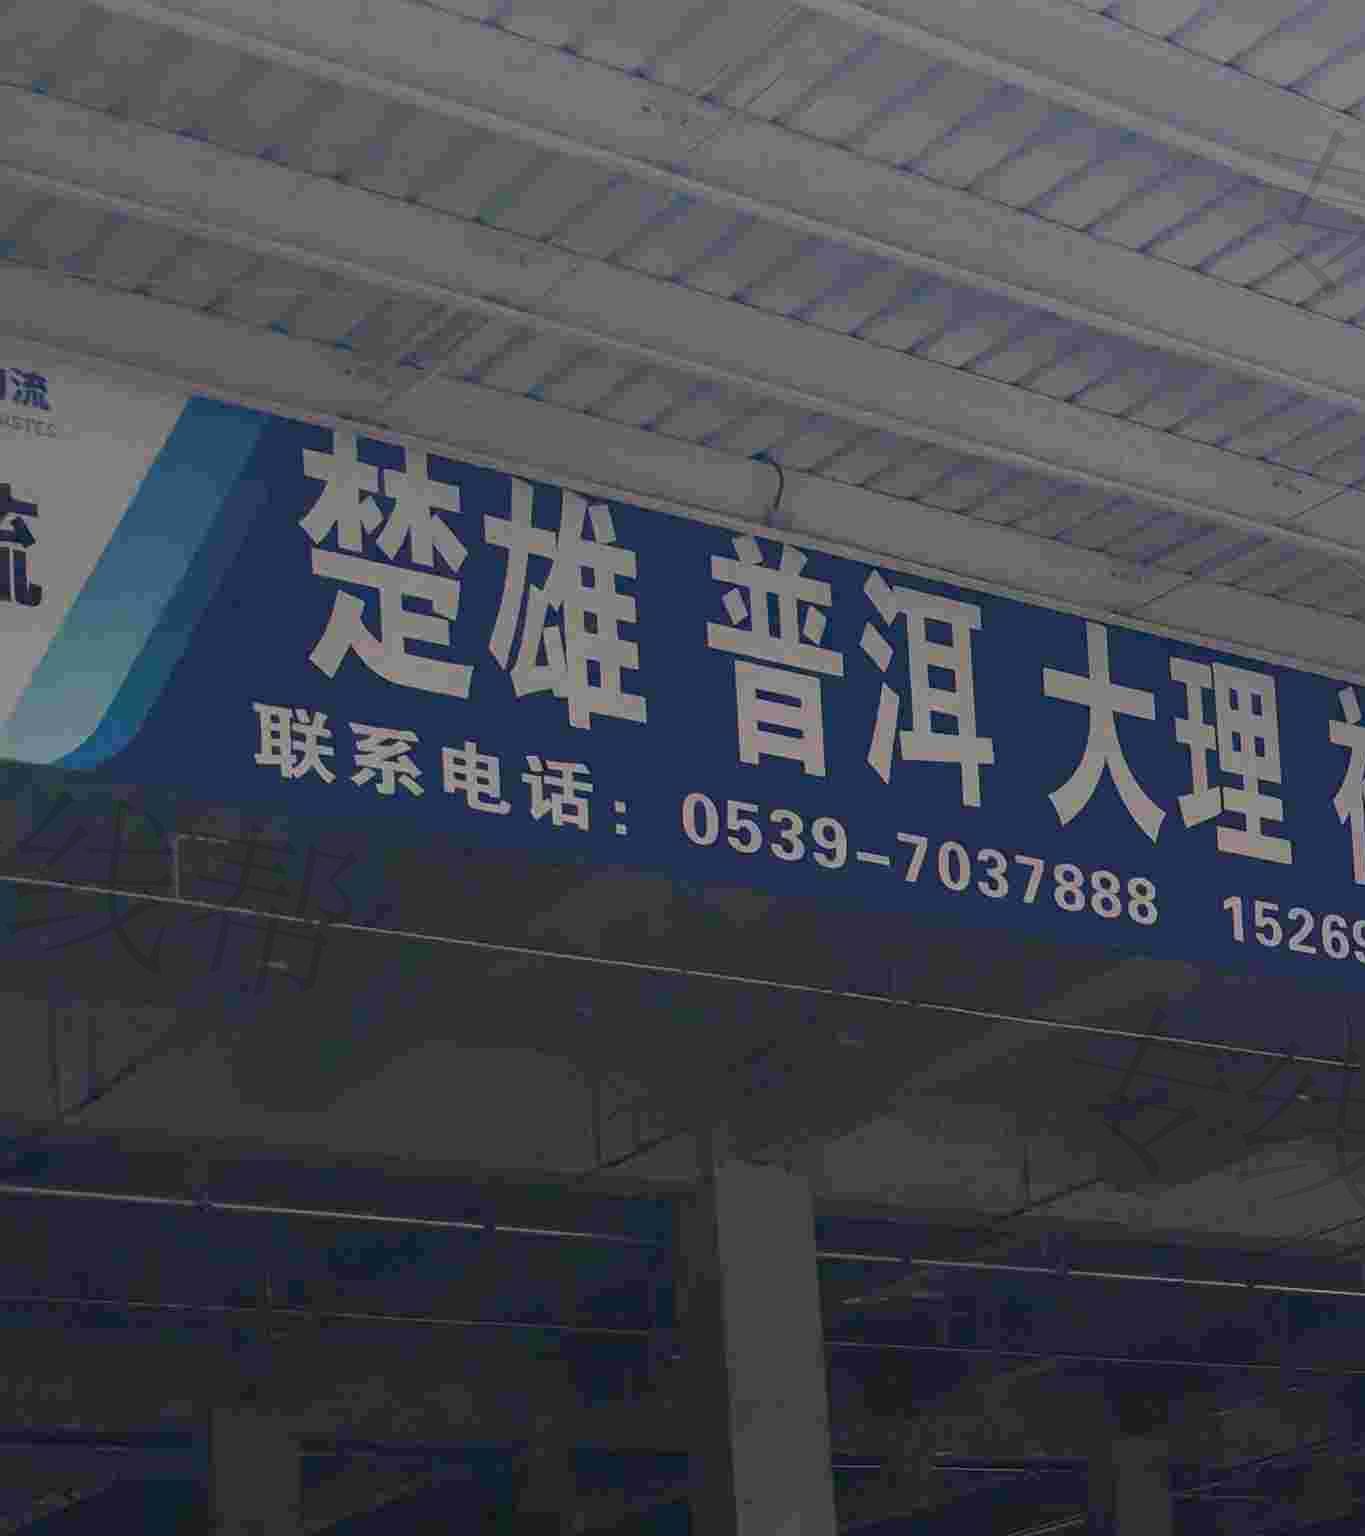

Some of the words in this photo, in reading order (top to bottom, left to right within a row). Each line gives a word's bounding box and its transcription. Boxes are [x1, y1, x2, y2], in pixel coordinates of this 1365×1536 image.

[299, 430, 647, 729] 楚雄
[705, 532, 994, 808] 普洱
[1042, 621, 1292, 864] 大理
[681, 792, 1160, 925] 0539-7037888
